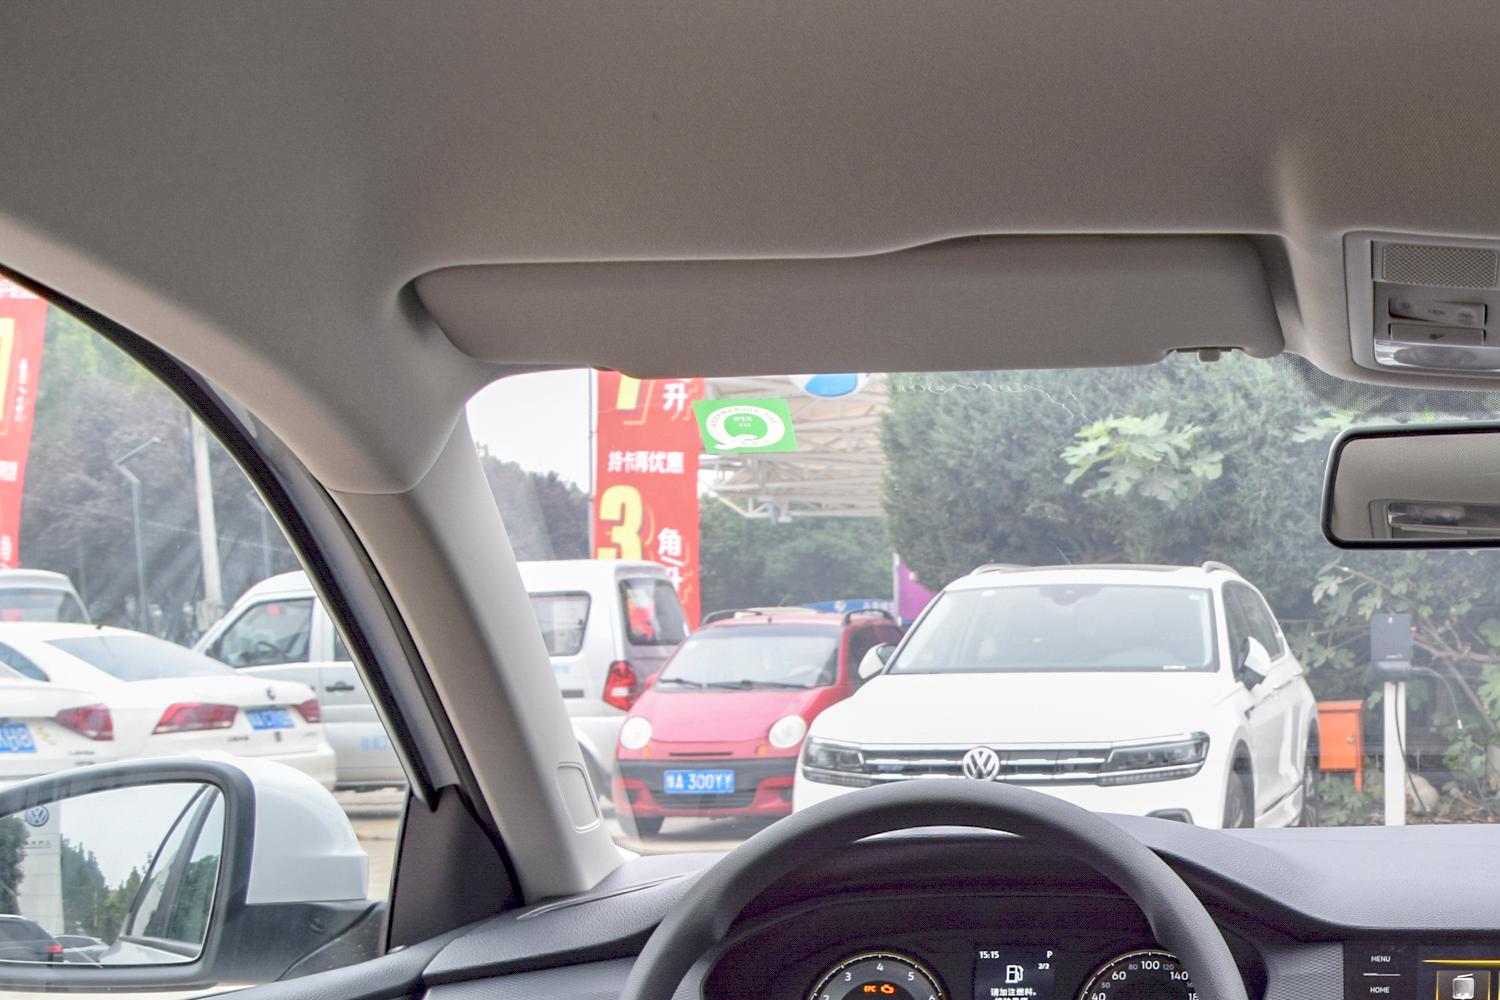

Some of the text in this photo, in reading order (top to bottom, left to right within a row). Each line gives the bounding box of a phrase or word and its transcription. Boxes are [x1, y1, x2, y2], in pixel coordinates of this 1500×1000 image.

[608, 451, 684, 473] 持卡再优惠
[597, 485, 642, 560] 3
[979, 951, 1000, 959] 15:15
[1046, 950, 1053, 959] P
[876, 962, 884, 972] 4
[1140, 960, 1160, 970] 100
[844, 972, 852, 982] 3
[907, 972, 915, 981] 5
[1111, 971, 1127, 980] 60
[1170, 971, 1189, 980] 140
[1369, 986, 1390, 994] HOME
